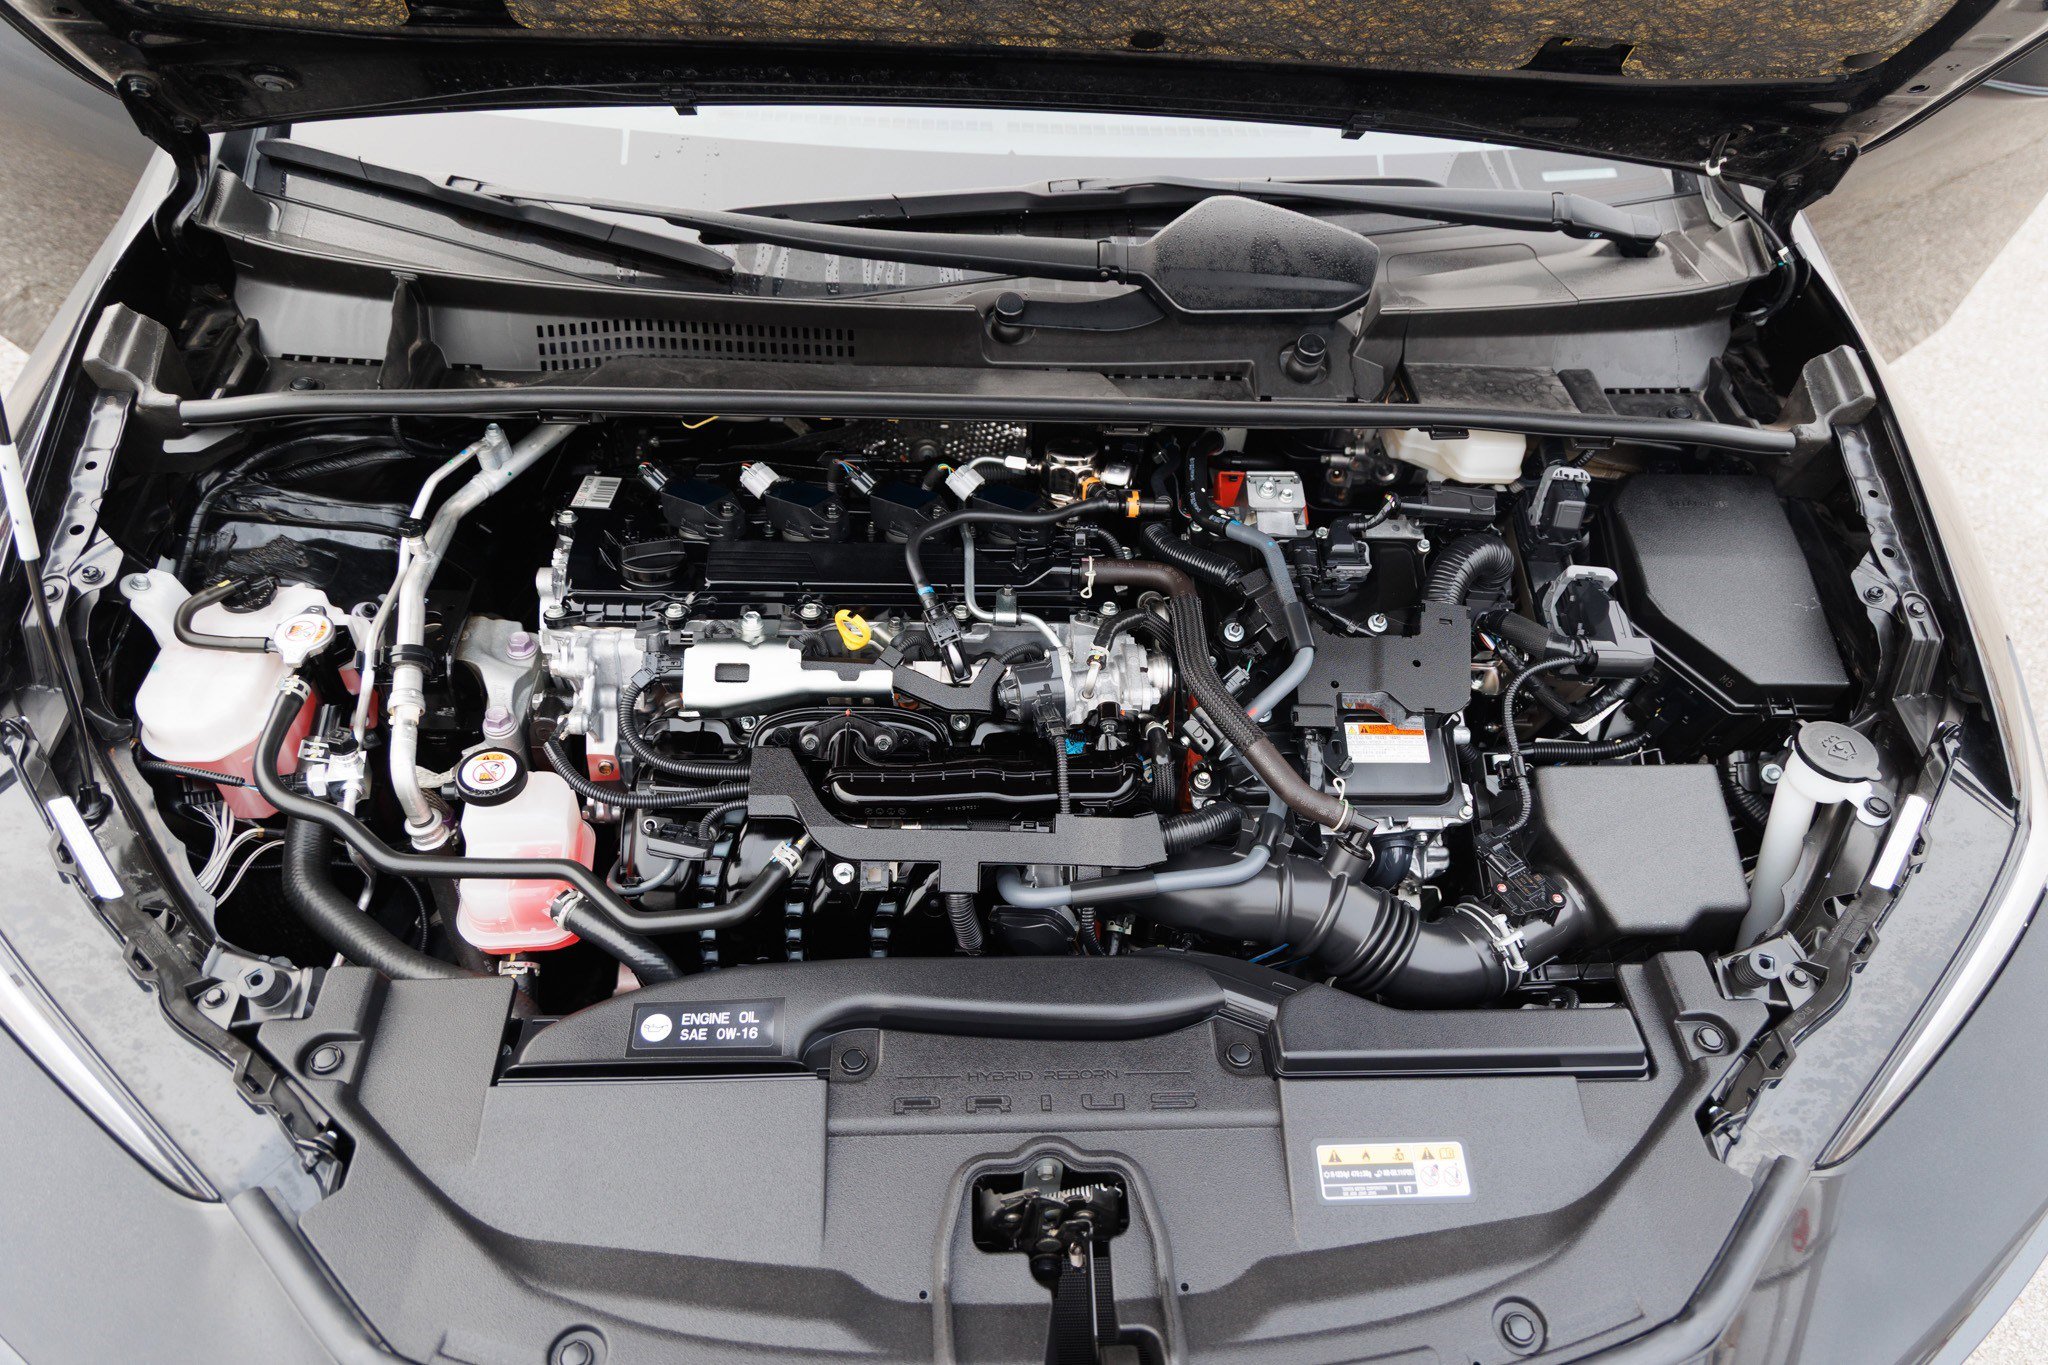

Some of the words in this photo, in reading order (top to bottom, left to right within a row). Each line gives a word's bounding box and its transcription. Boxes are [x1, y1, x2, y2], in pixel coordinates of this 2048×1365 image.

[681, 1012, 730, 1025] ENGINE
[738, 1011, 760, 1024] OIL
[680, 1028, 708, 1041] SAE
[716, 1027, 758, 1040] 0W-16
[967, 1071, 1033, 1082] HYBRID
[1044, 1070, 1119, 1080] REBORN
[893, 1092, 1198, 1115] PRIUS
